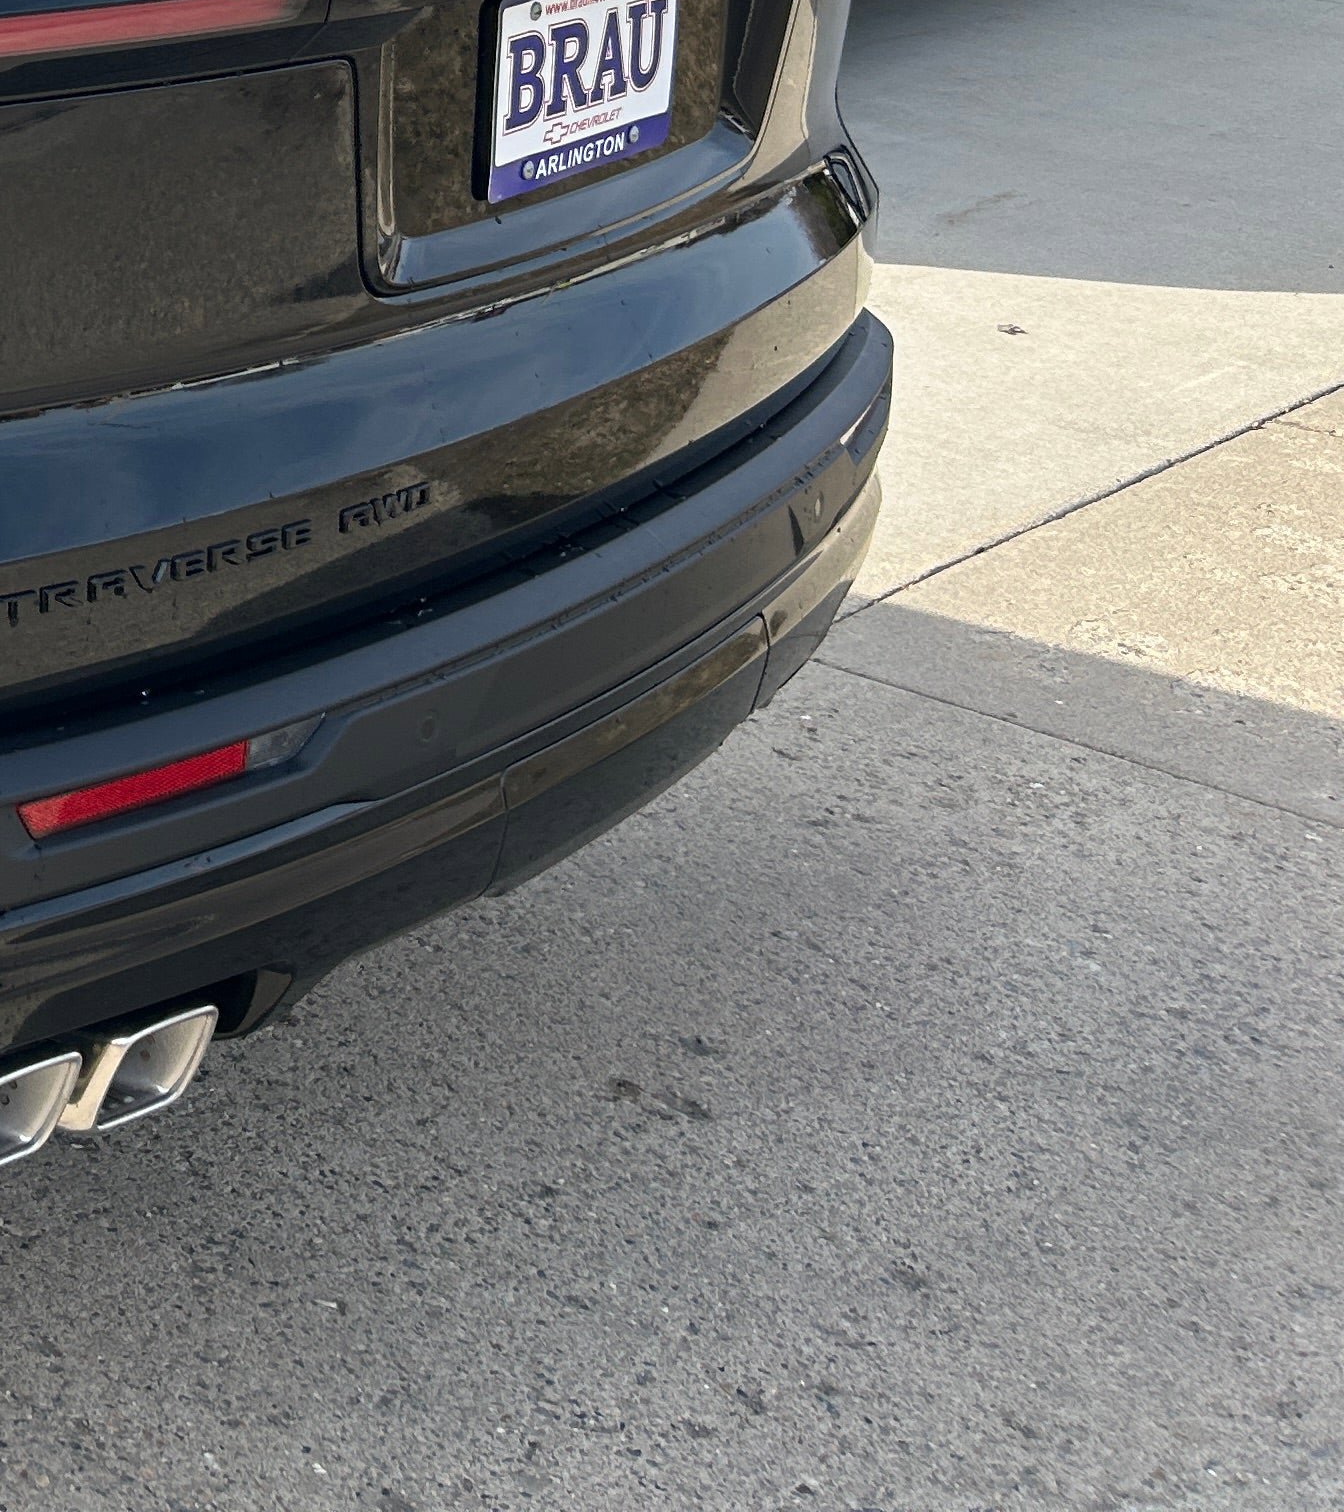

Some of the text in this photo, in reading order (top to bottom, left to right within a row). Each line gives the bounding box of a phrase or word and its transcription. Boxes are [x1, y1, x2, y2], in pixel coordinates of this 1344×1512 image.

[569, 107, 623, 135] CHEVROLET
[535, 132, 625, 179] ARLINGTON
[338, 481, 431, 534] AWD
